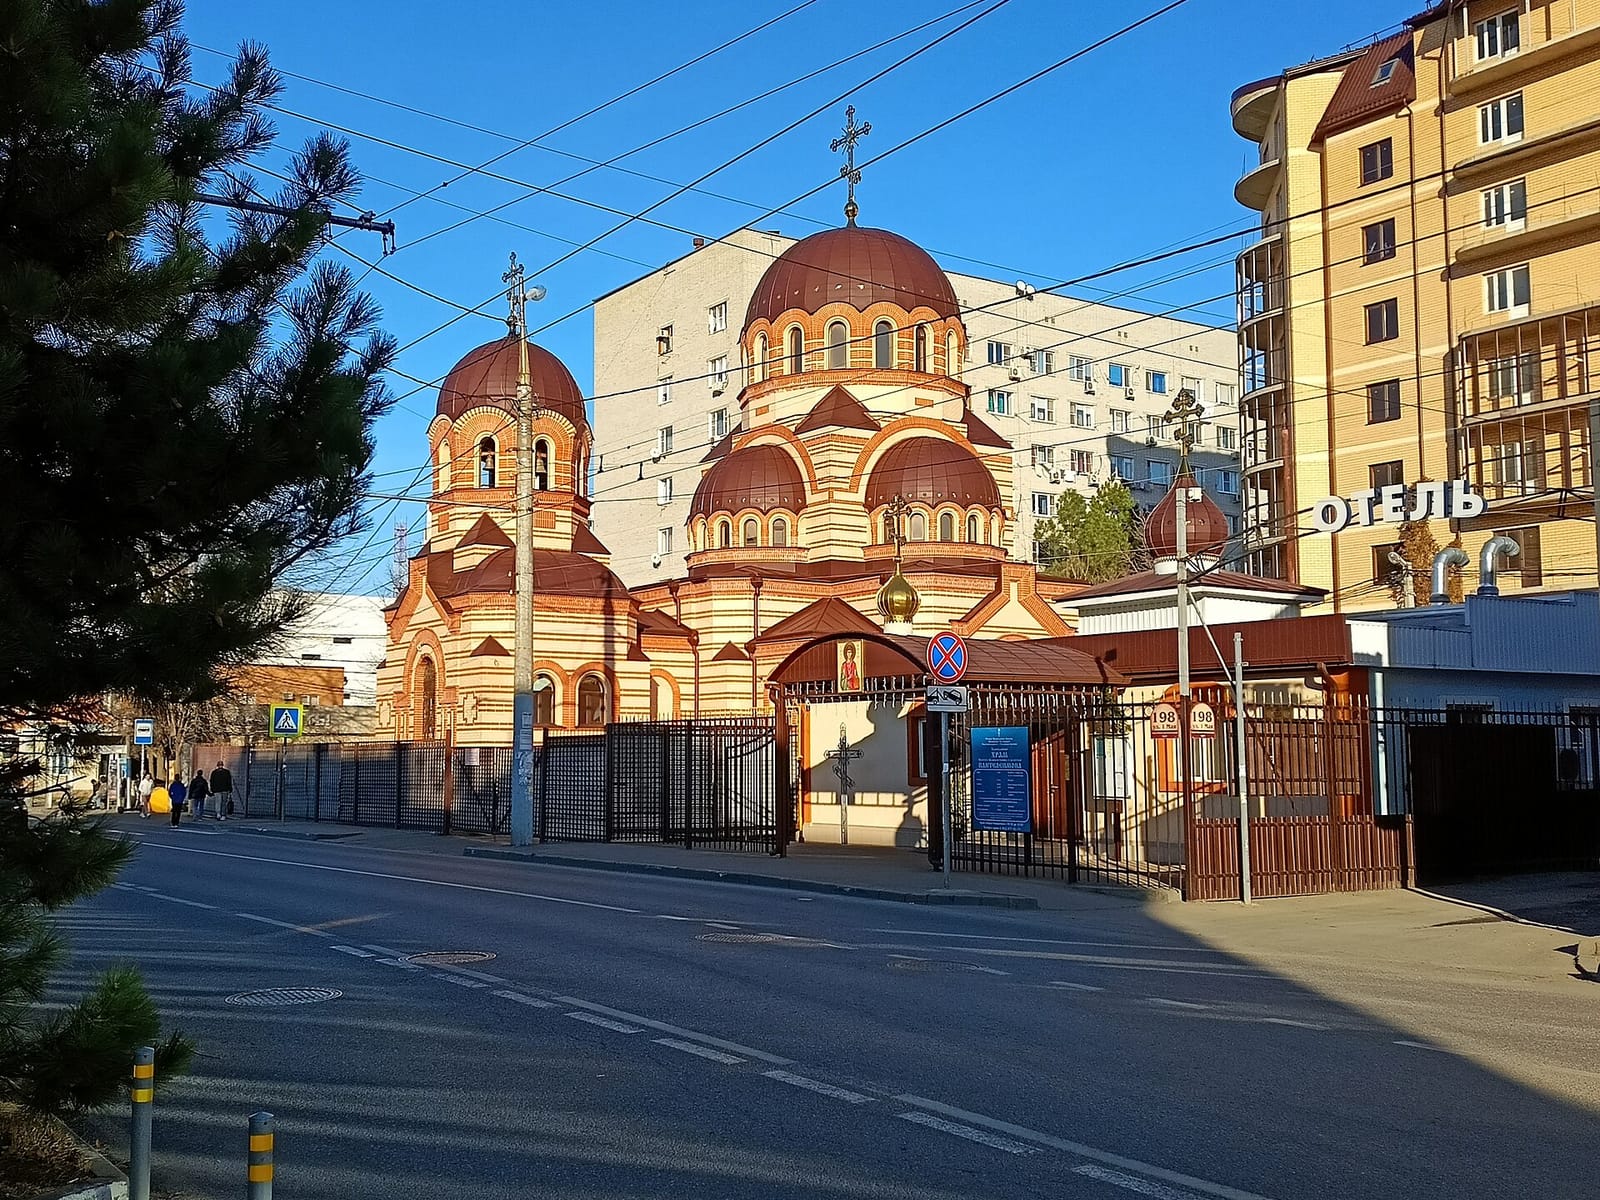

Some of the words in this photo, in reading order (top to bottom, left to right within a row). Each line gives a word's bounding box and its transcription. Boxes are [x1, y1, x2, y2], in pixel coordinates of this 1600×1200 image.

[1312, 480, 1487, 533] ОТЕЛЬ
[1153, 711, 1175, 723] 198
[1193, 711, 1212, 722] 198
